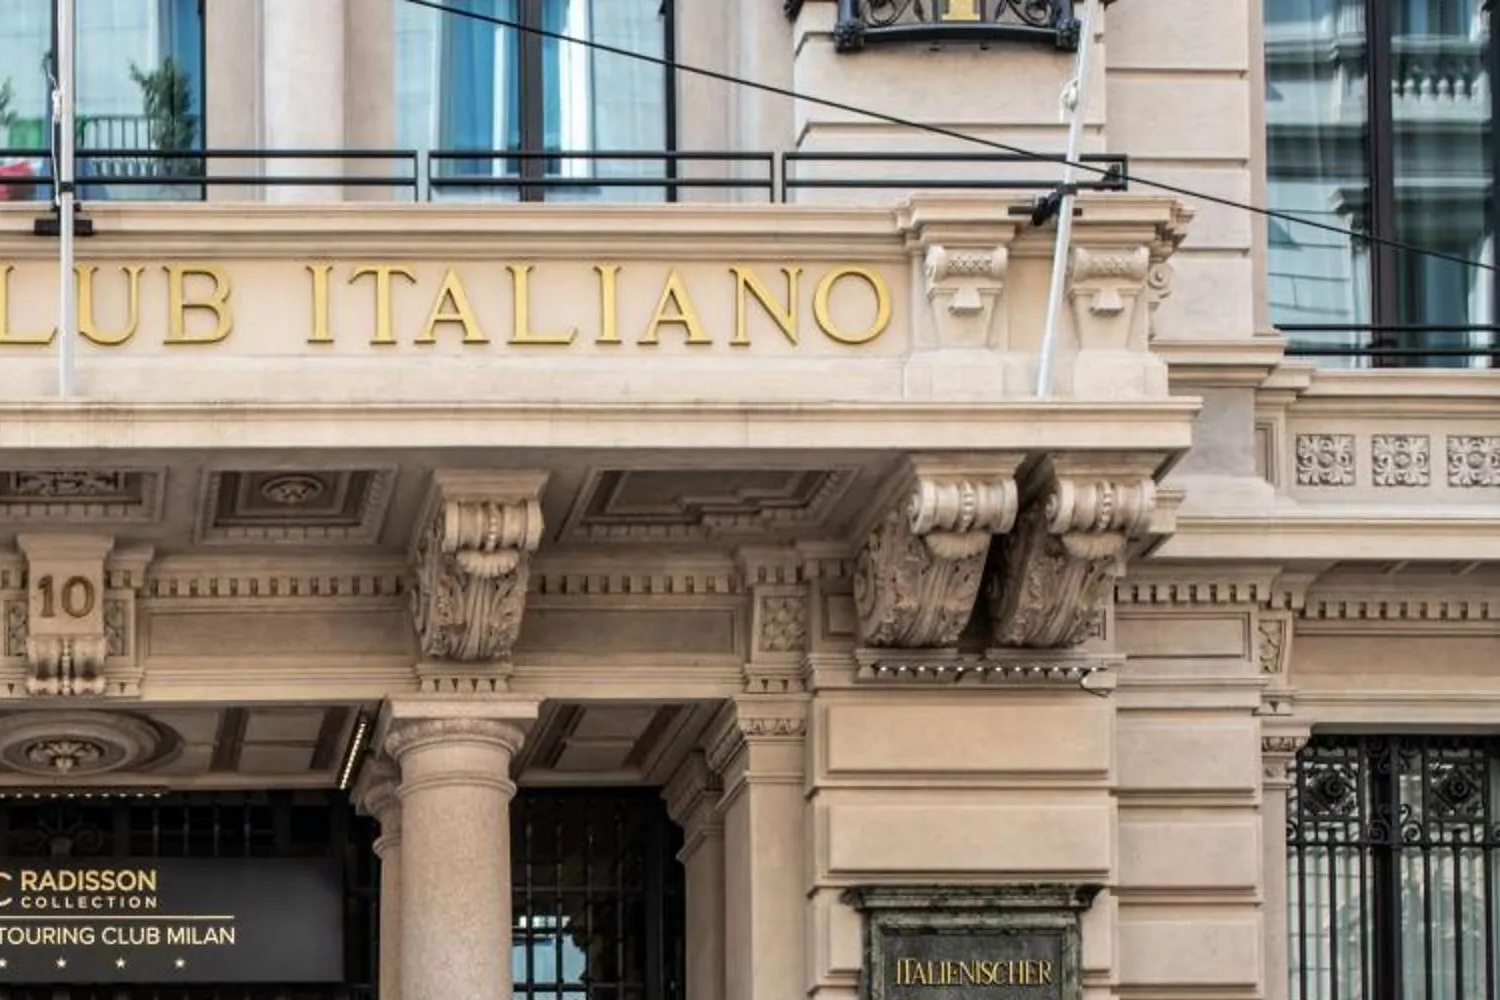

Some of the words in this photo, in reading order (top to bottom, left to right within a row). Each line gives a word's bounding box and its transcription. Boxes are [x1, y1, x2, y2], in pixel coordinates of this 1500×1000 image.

[306, 264, 893, 346] ITALIANO
[37, 574, 96, 619] 10
[20, 869, 157, 892] RADISSON
[20, 896, 157, 909] COLLECTION
[100, 926, 161, 946] CLUB
[166, 926, 236, 946] MILAN
[896, 957, 1053, 986] ITALIENISCHER
